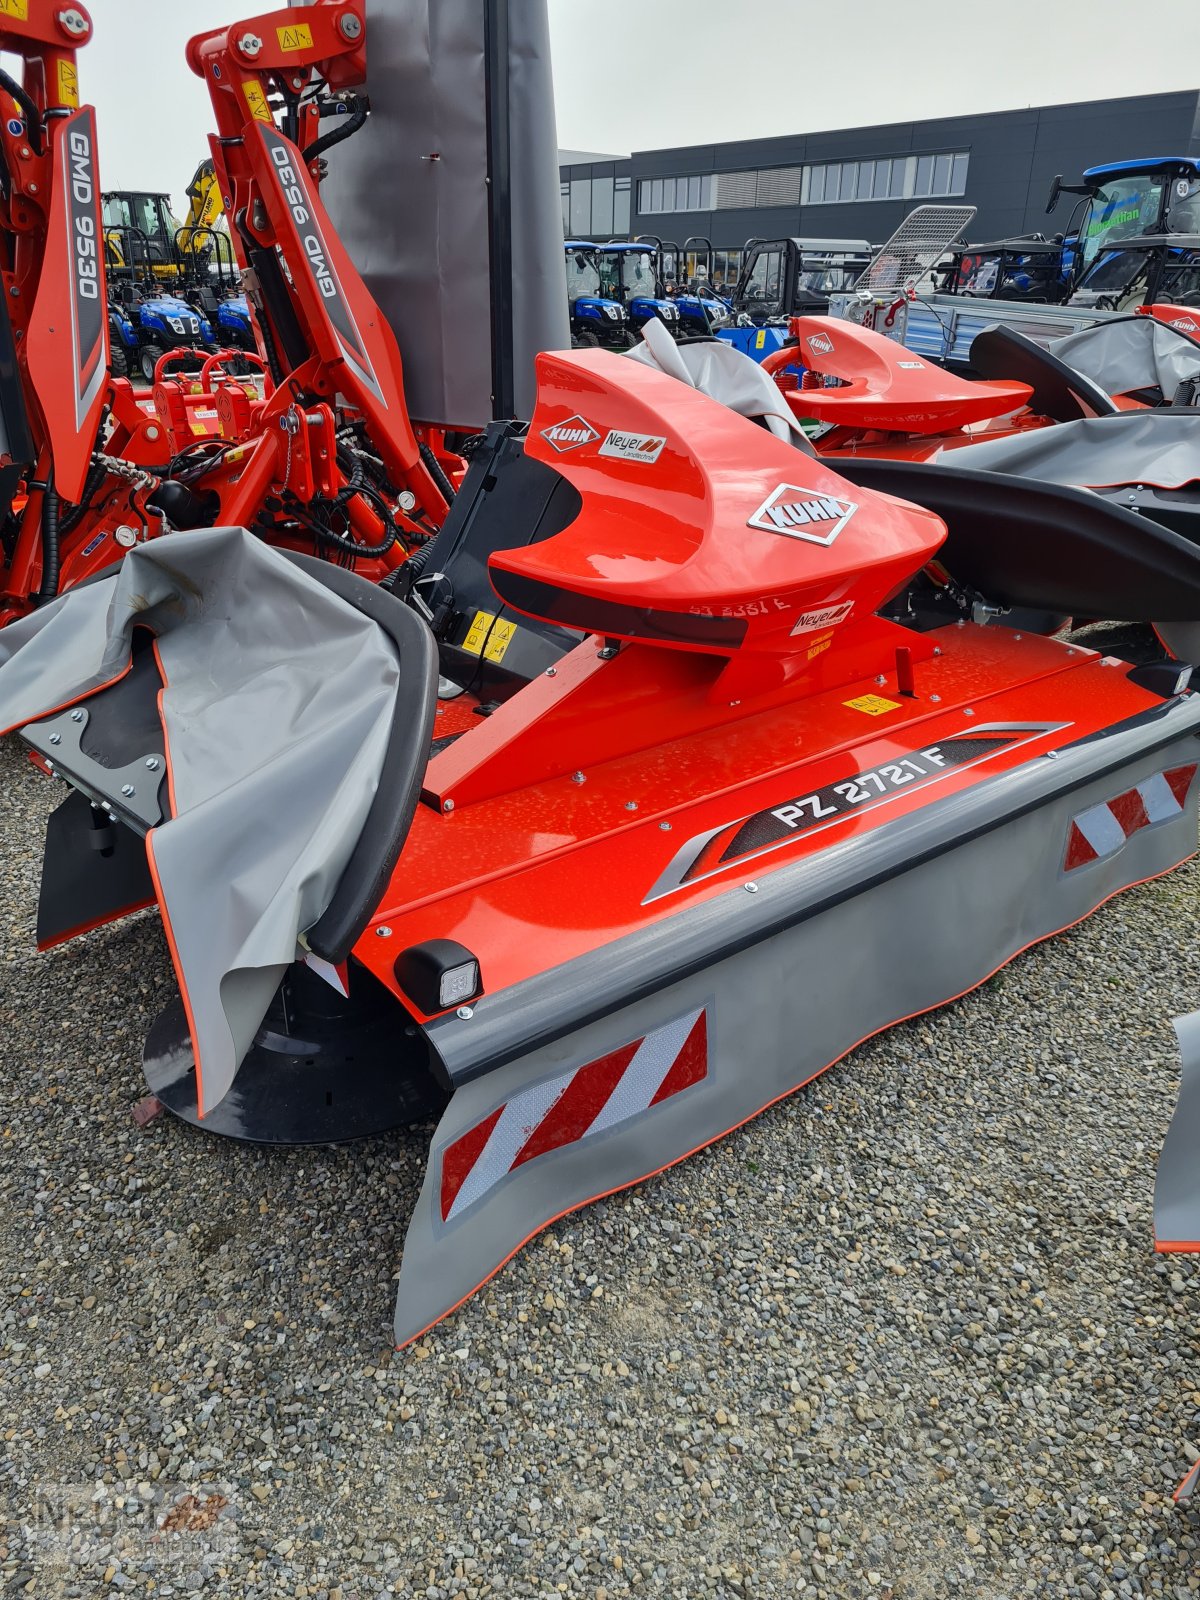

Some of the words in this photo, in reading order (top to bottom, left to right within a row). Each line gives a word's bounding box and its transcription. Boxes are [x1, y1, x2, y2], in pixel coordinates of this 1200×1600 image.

[70, 132, 92, 203] GMD
[272, 146, 309, 225] 9530
[1179, 183, 1188, 194] 50
[76, 216, 98, 299] 9530
[305, 235, 337, 298] GMD
[1173, 320, 1196, 331] KUHN
[810, 337, 831, 352] KUHN
[548, 427, 592, 442] KUHN
[606, 432, 642, 450] Neyer
[623, 450, 656, 461] Landtechnik
[765, 498, 846, 528] KUHN
[796, 611, 832, 627] Neyer
[771, 795, 838, 828] PZ
[833, 760, 928, 804] 2721
[920, 747, 946, 767] F
